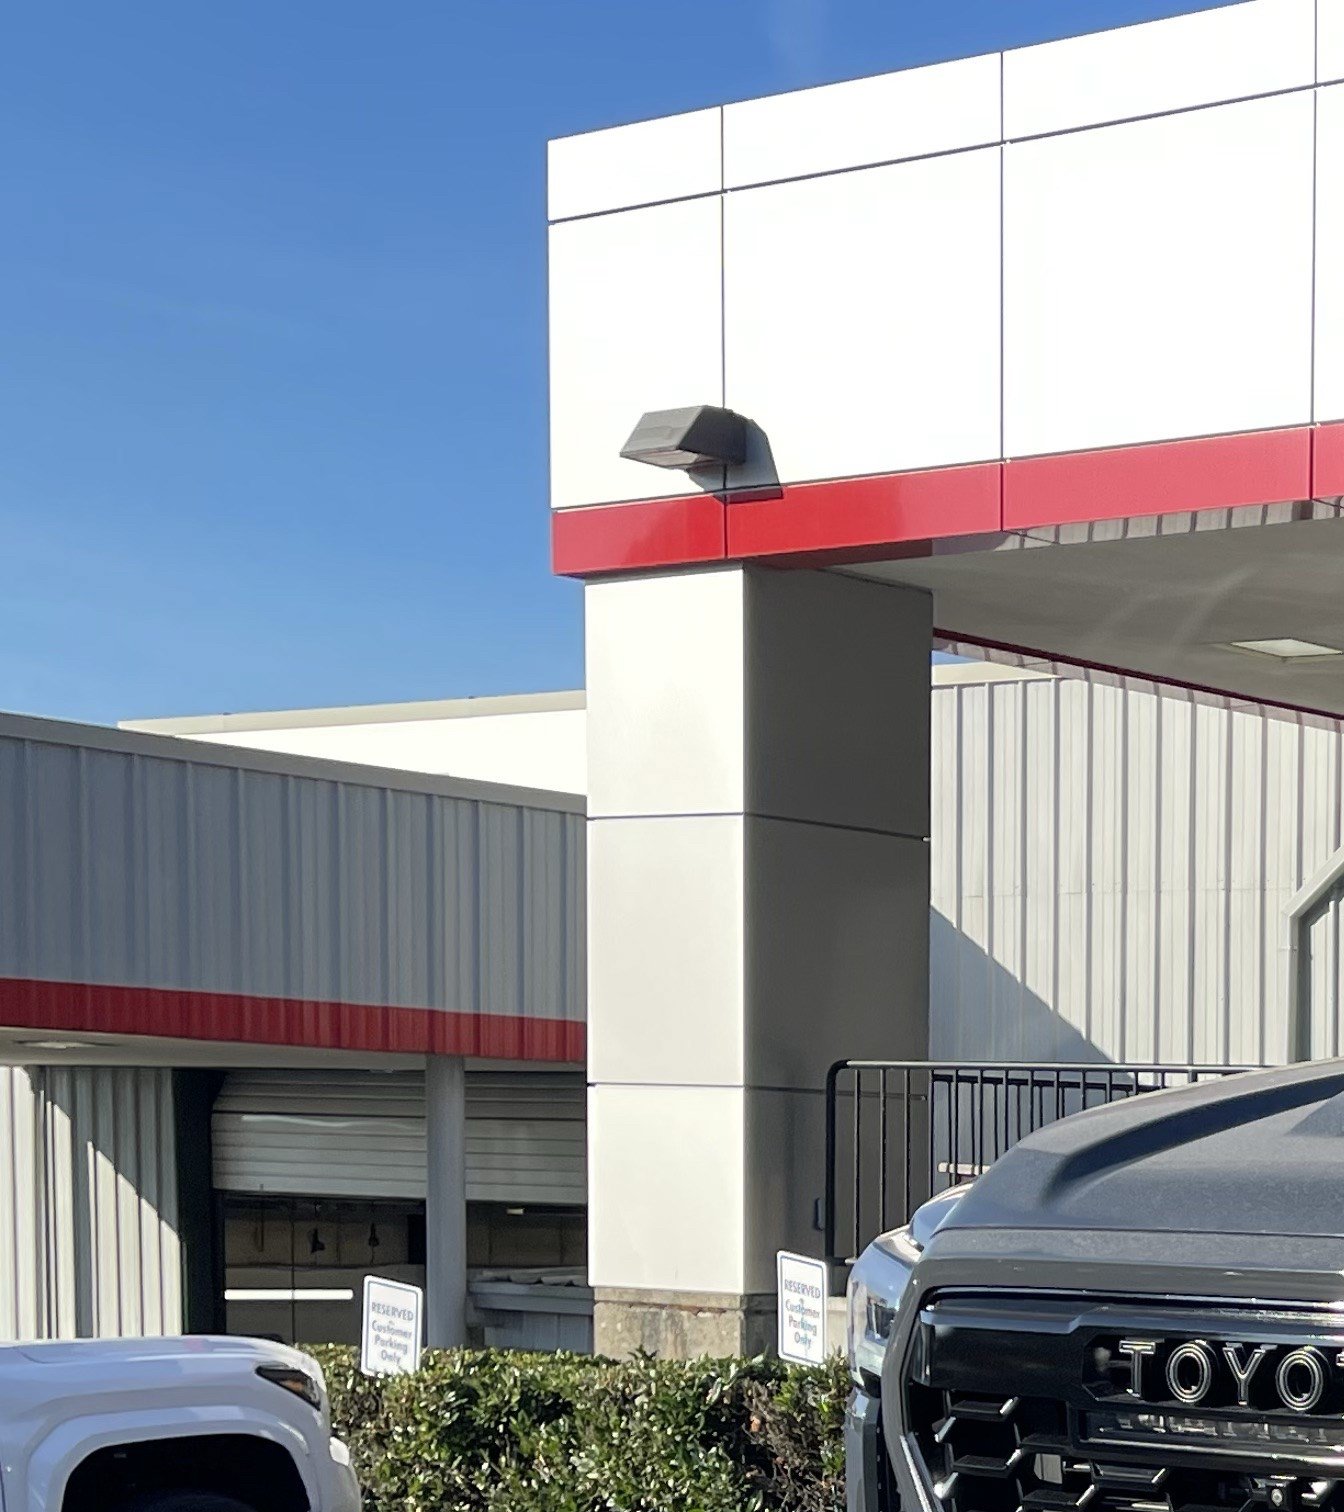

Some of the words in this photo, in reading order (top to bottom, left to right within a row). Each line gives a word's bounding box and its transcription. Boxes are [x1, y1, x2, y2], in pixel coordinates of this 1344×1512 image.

[783, 1279, 821, 1299] RESERVED
[371, 1302, 414, 1322] RESERVED
[785, 1299, 820, 1319] Customer
[372, 1320, 412, 1339] Customer
[788, 1315, 817, 1336] Parking
[374, 1334, 408, 1356] Parking
[794, 1332, 812, 1350] Only
[381, 1350, 402, 1365] Only
